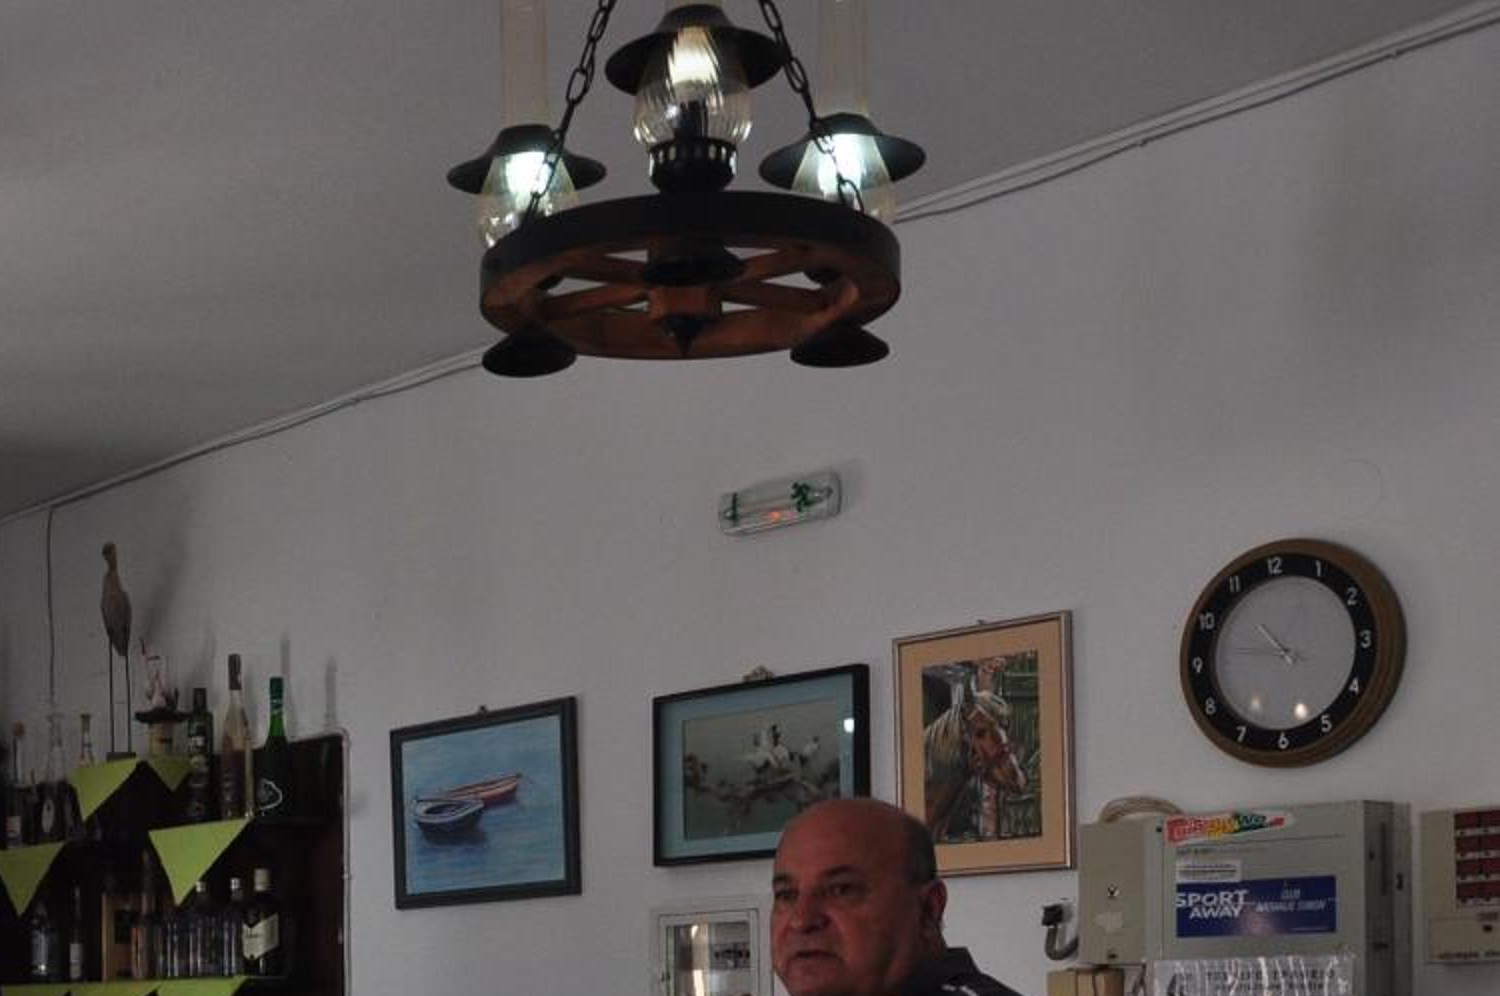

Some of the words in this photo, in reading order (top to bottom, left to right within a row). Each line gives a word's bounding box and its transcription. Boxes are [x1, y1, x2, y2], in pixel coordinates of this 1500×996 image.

[1267, 556, 1283, 574] 12
[1314, 560, 1322, 576] 1
[1229, 576, 1240, 592] 11
[1347, 587, 1358, 605] 2
[1200, 612, 1215, 630] 10
[1359, 630, 1372, 648] 3
[1192, 657, 1203, 673] 9
[1349, 677, 1360, 694] 4
[1205, 697, 1216, 715] 8
[1320, 714, 1332, 732] 5
[1236, 725, 1247, 742] 7
[1278, 731, 1290, 749] 6
[1176, 889, 1251, 908] SPORT
[1189, 906, 1244, 920] AWAY
